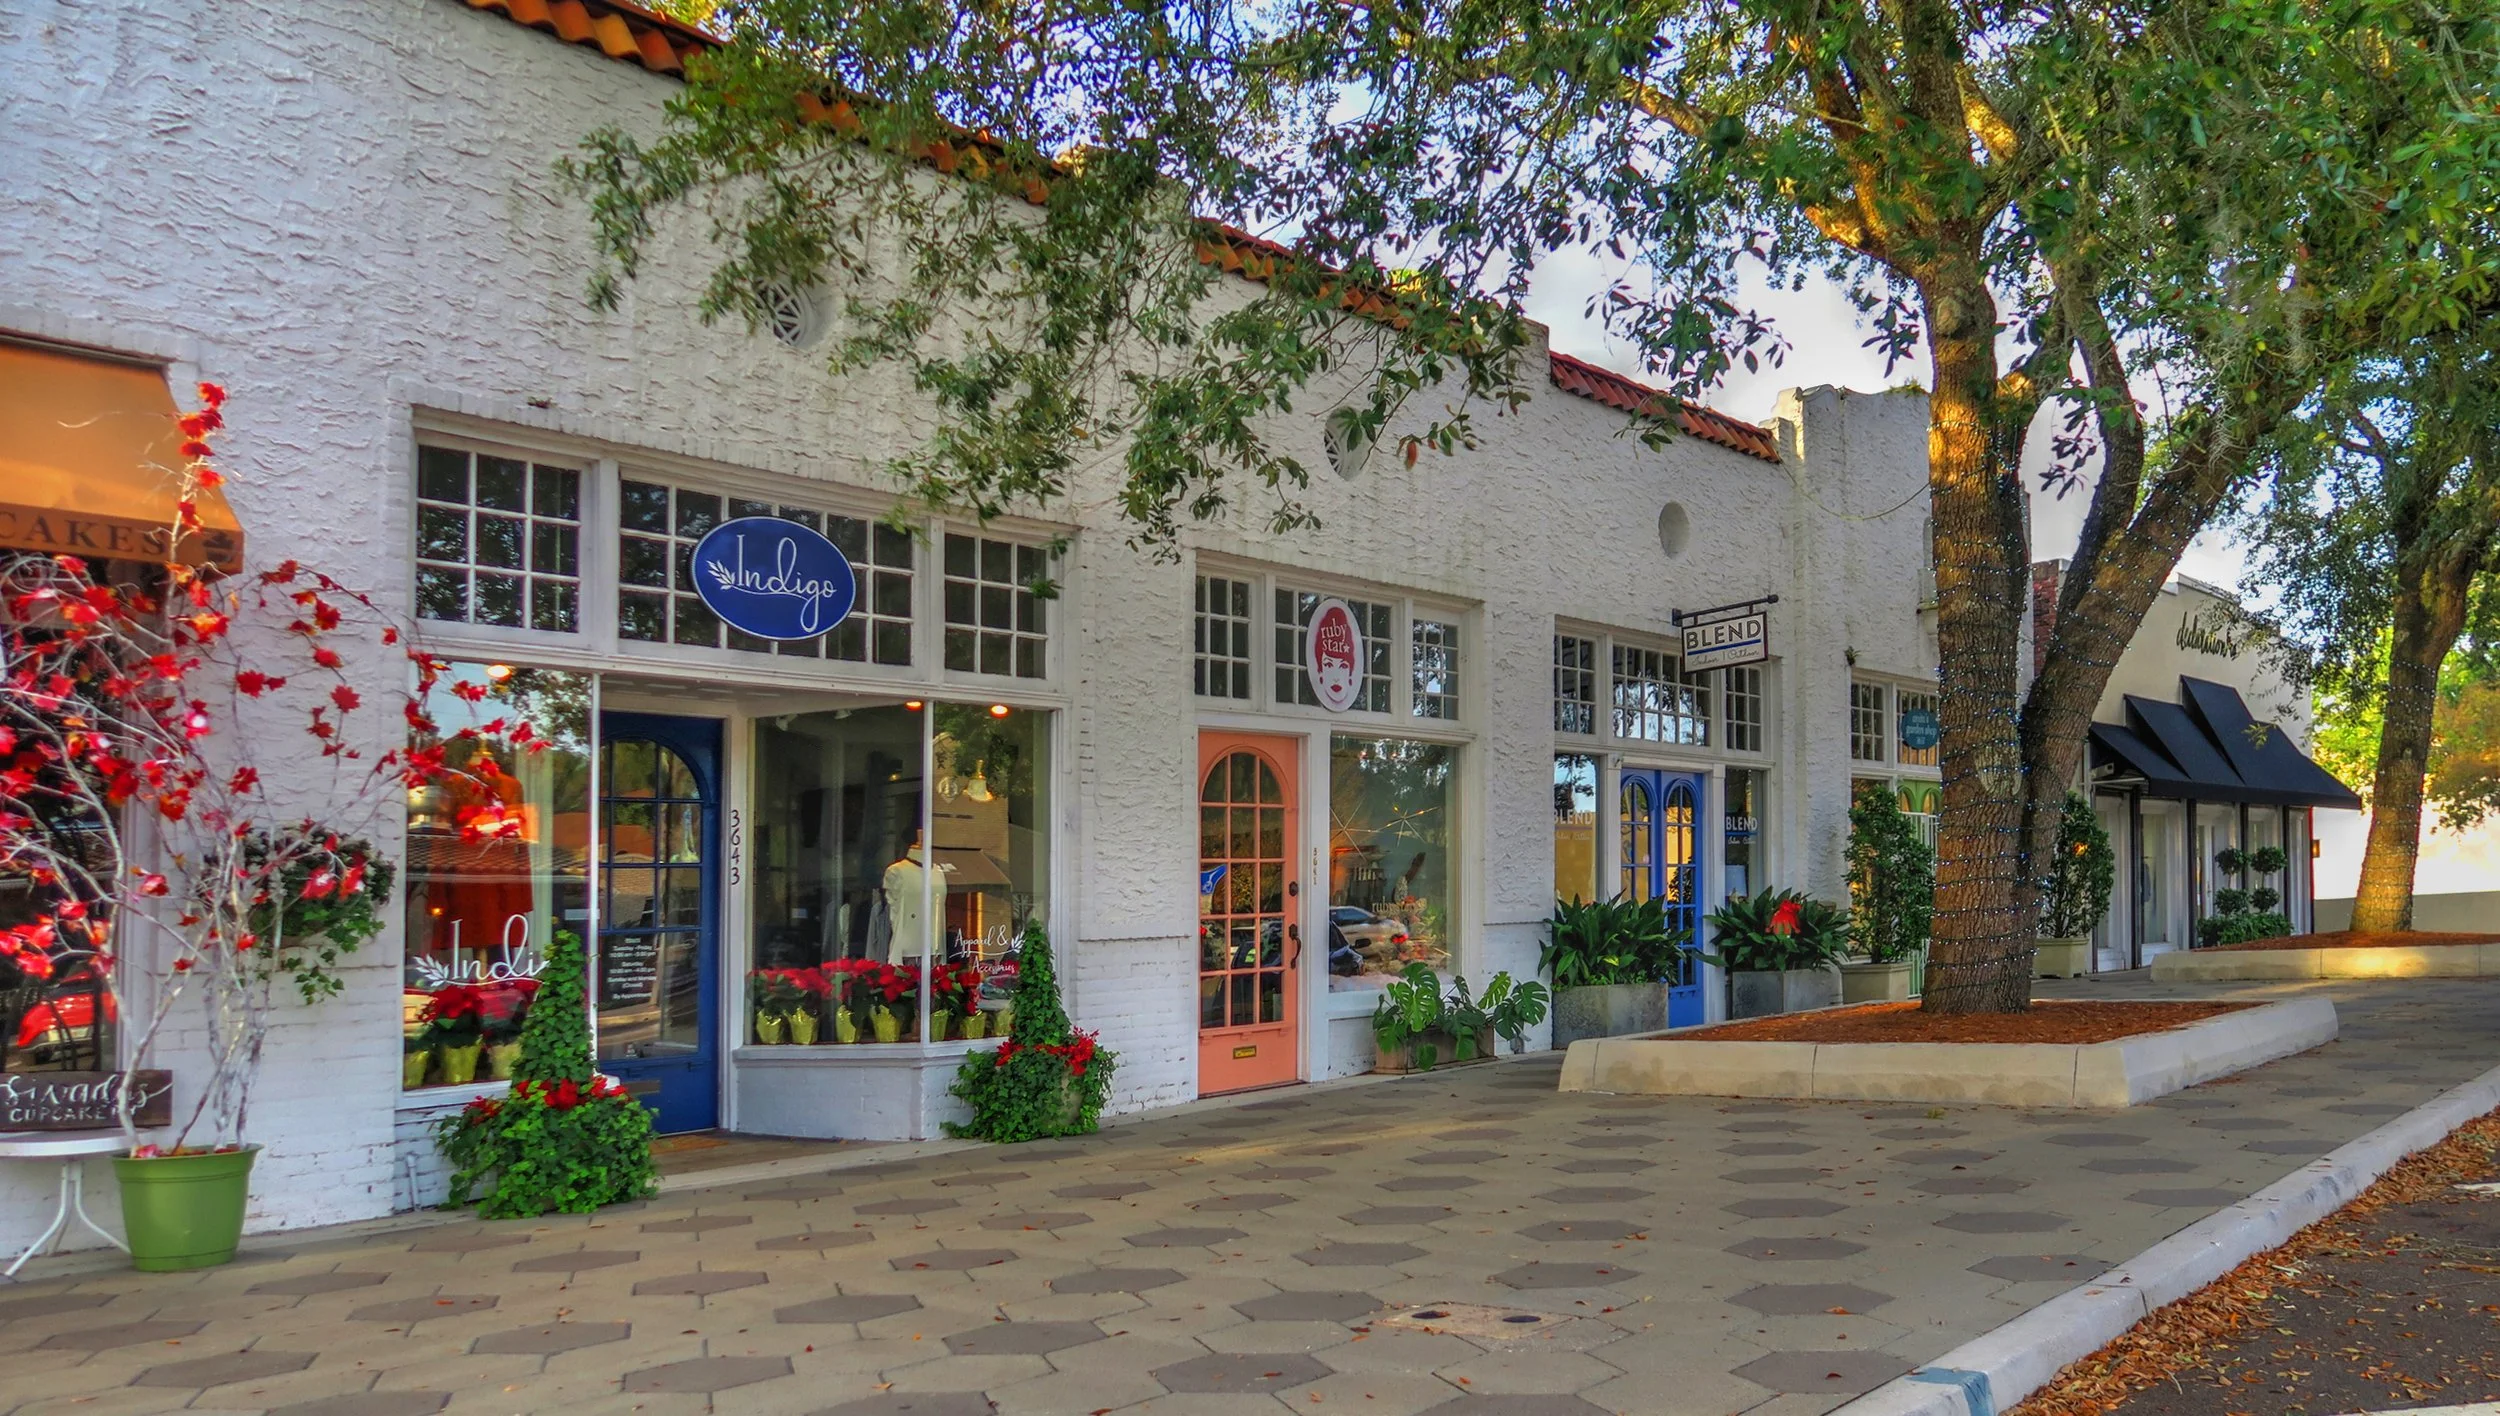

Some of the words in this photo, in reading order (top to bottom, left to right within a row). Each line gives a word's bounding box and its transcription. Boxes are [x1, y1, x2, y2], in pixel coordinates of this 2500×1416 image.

[736, 534, 838, 633] Indigo
[1321, 617, 1347, 642] ruby
[1686, 619, 1762, 650] BLEND
[1322, 638, 1344, 653] star
[1726, 815, 1758, 832] BLEND
[731, 809, 741, 886] 3643
[450, 913, 550, 981] Indi
